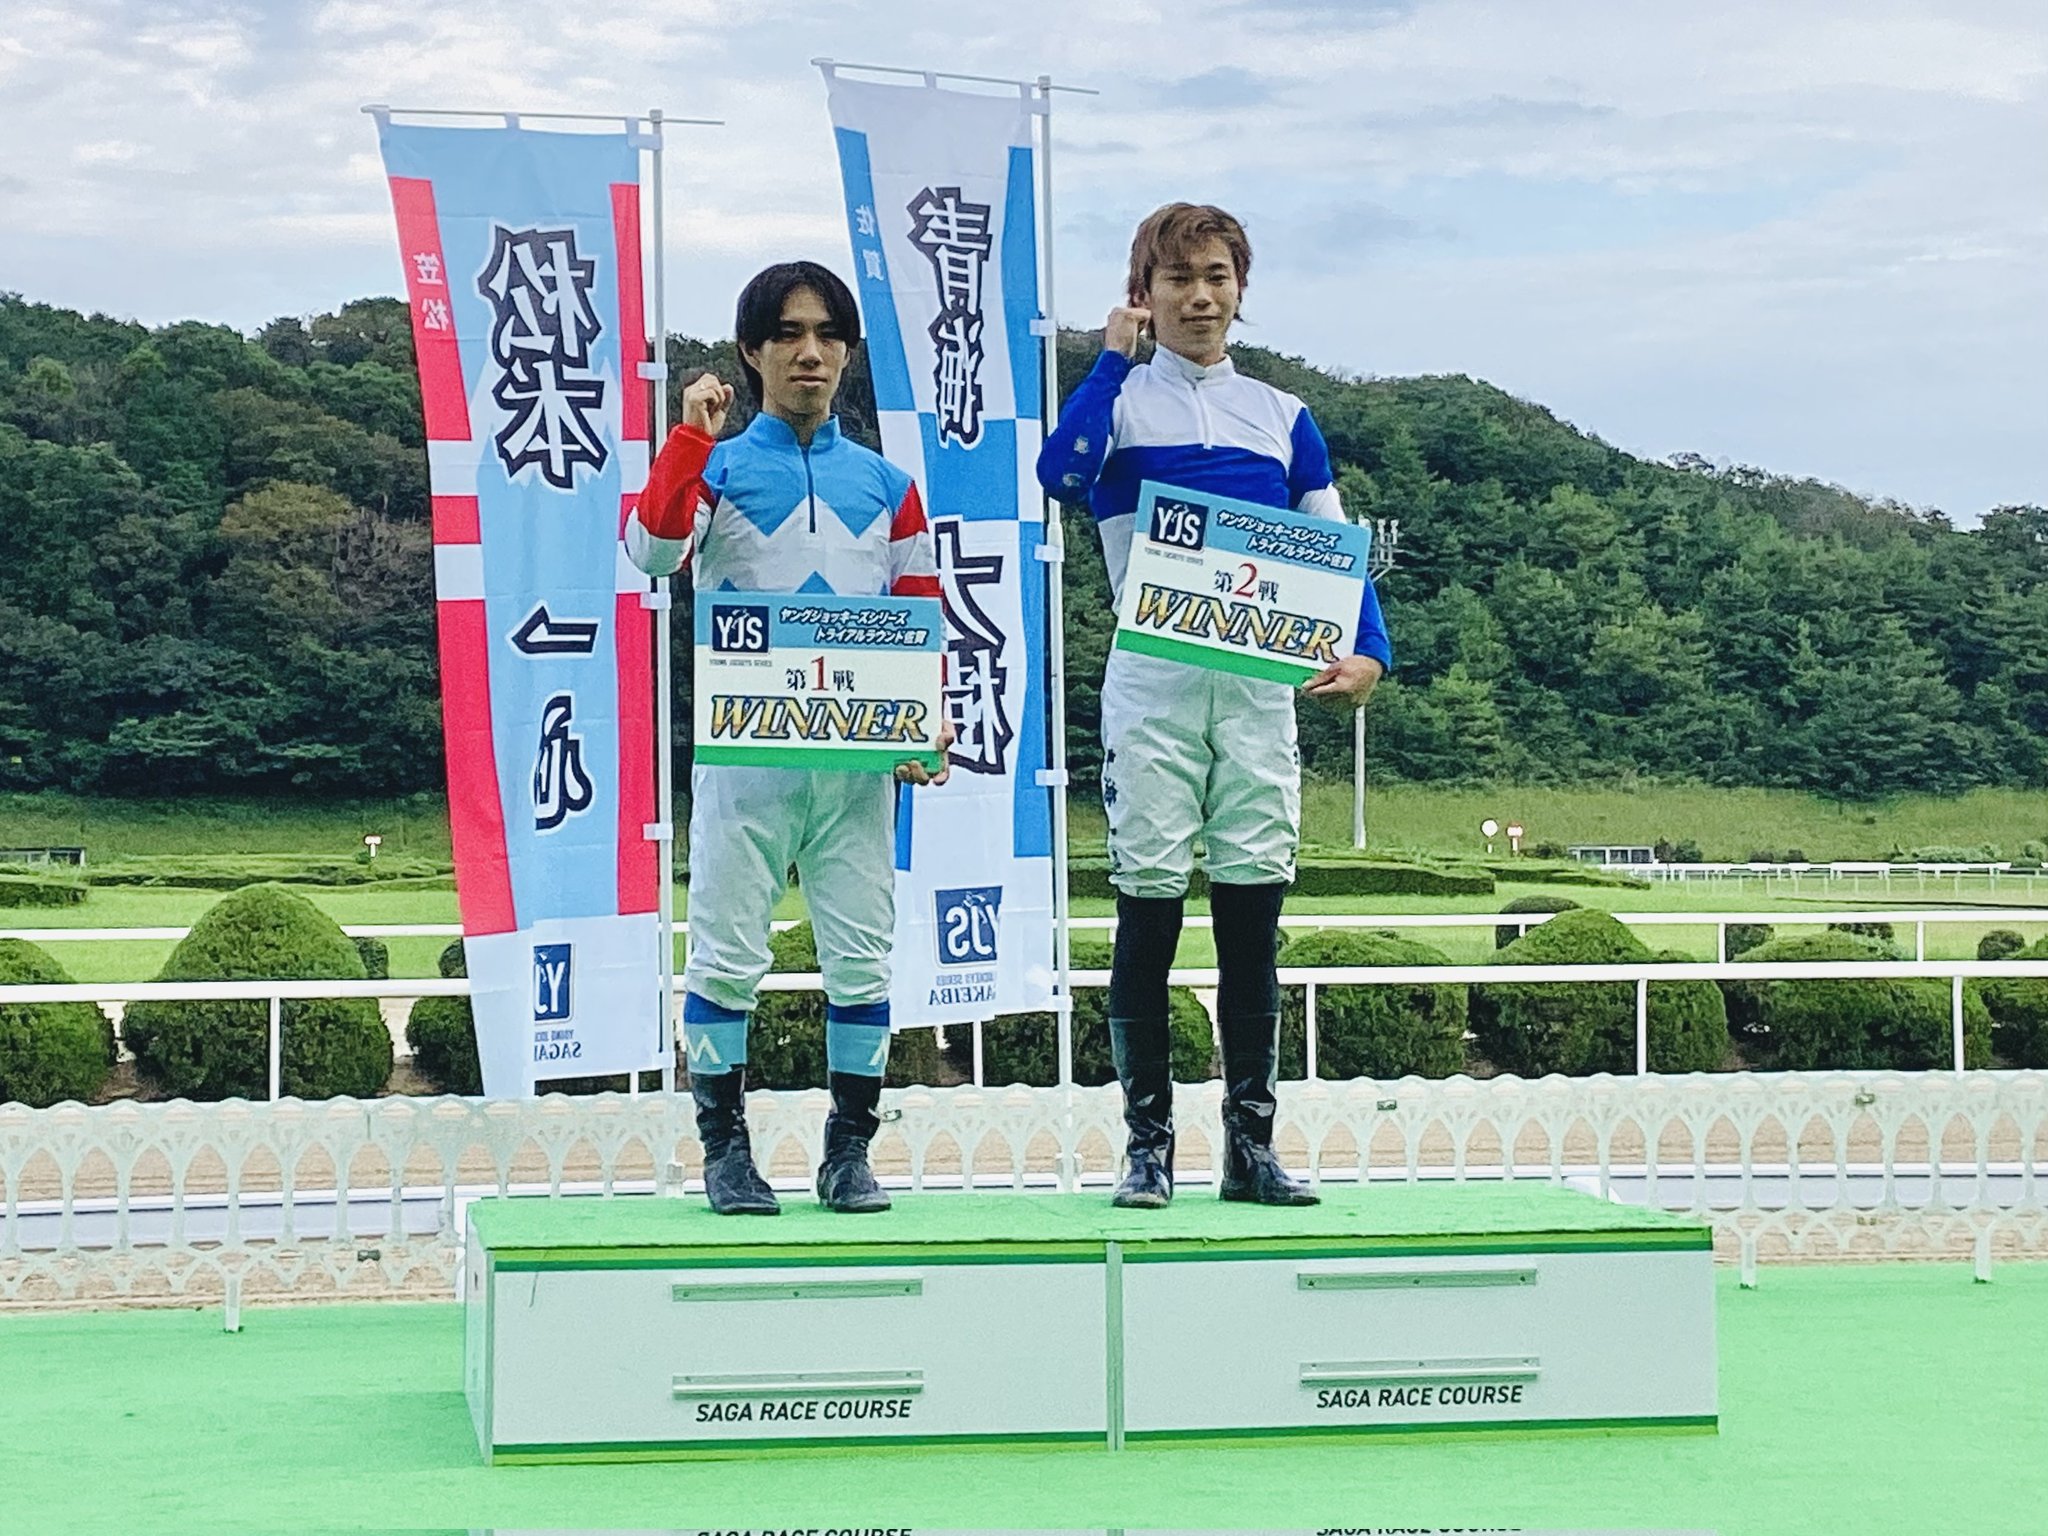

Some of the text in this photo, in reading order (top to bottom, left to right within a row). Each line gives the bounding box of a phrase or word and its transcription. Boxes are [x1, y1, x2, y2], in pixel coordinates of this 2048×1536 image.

[1157, 506, 1201, 547] YJS
[1217, 509, 1341, 548] ヤングジョッキーズシリーズ
[1246, 535, 1355, 570] トライアルラウンド佐賀
[1213, 562, 1279, 604] 第2戦
[716, 615, 763, 650] YJS
[779, 606, 911, 628] ヤングジョッキーズシリーズ
[1135, 583, 1342, 663] WINNER
[814, 625, 929, 646] トライアルラウンド佐賀
[785, 656, 855, 692] 第1戦
[711, 695, 929, 743] WINNER
[696, 1399, 912, 1422] SAGA RACE COURSE
[1317, 1385, 1523, 1408] SAGA RACE COURSE
